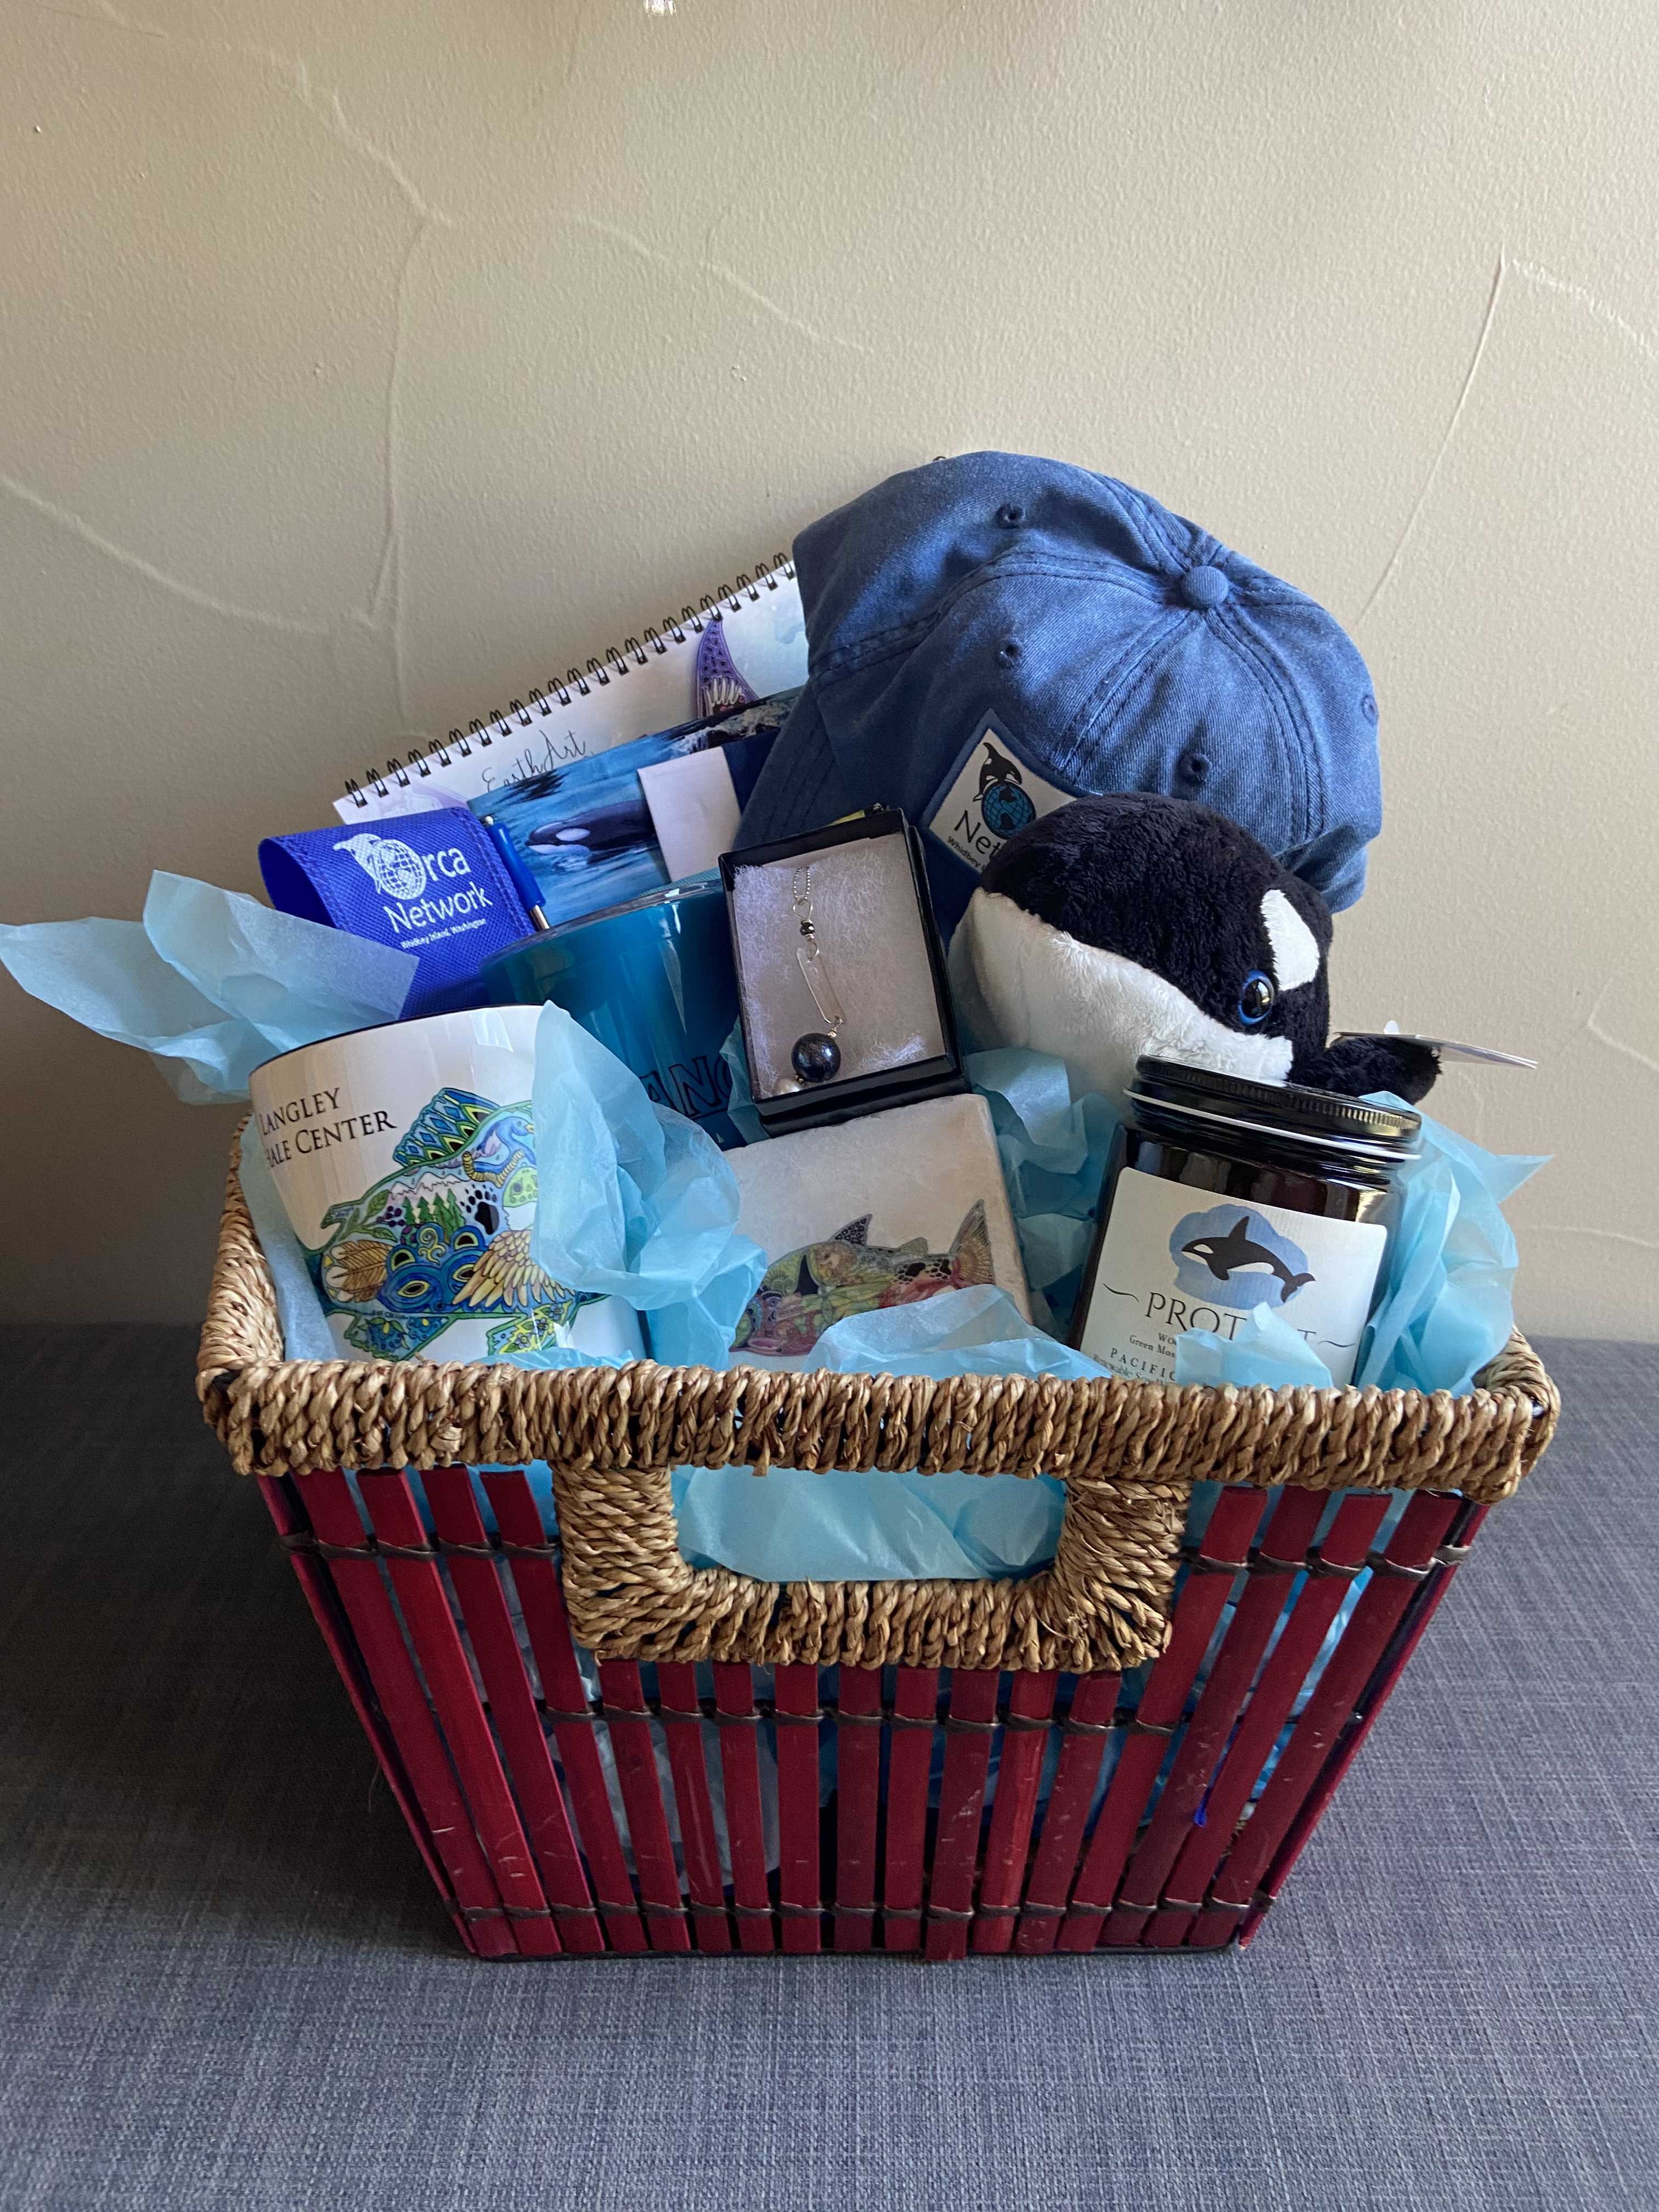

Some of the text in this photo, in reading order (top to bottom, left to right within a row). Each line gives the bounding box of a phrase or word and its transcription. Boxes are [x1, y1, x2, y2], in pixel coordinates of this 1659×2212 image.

[947, 835, 981, 868] Whidbey
[383, 881, 492, 933] Network
[259, 1087, 340, 1136] LANGLEY
[295, 1110, 397, 1154] CENTER
[1144, 1291, 1316, 1341] PROTT
[1110, 1347, 1176, 1381] PACIFIC
[1129, 1334, 1154, 1351] Green
